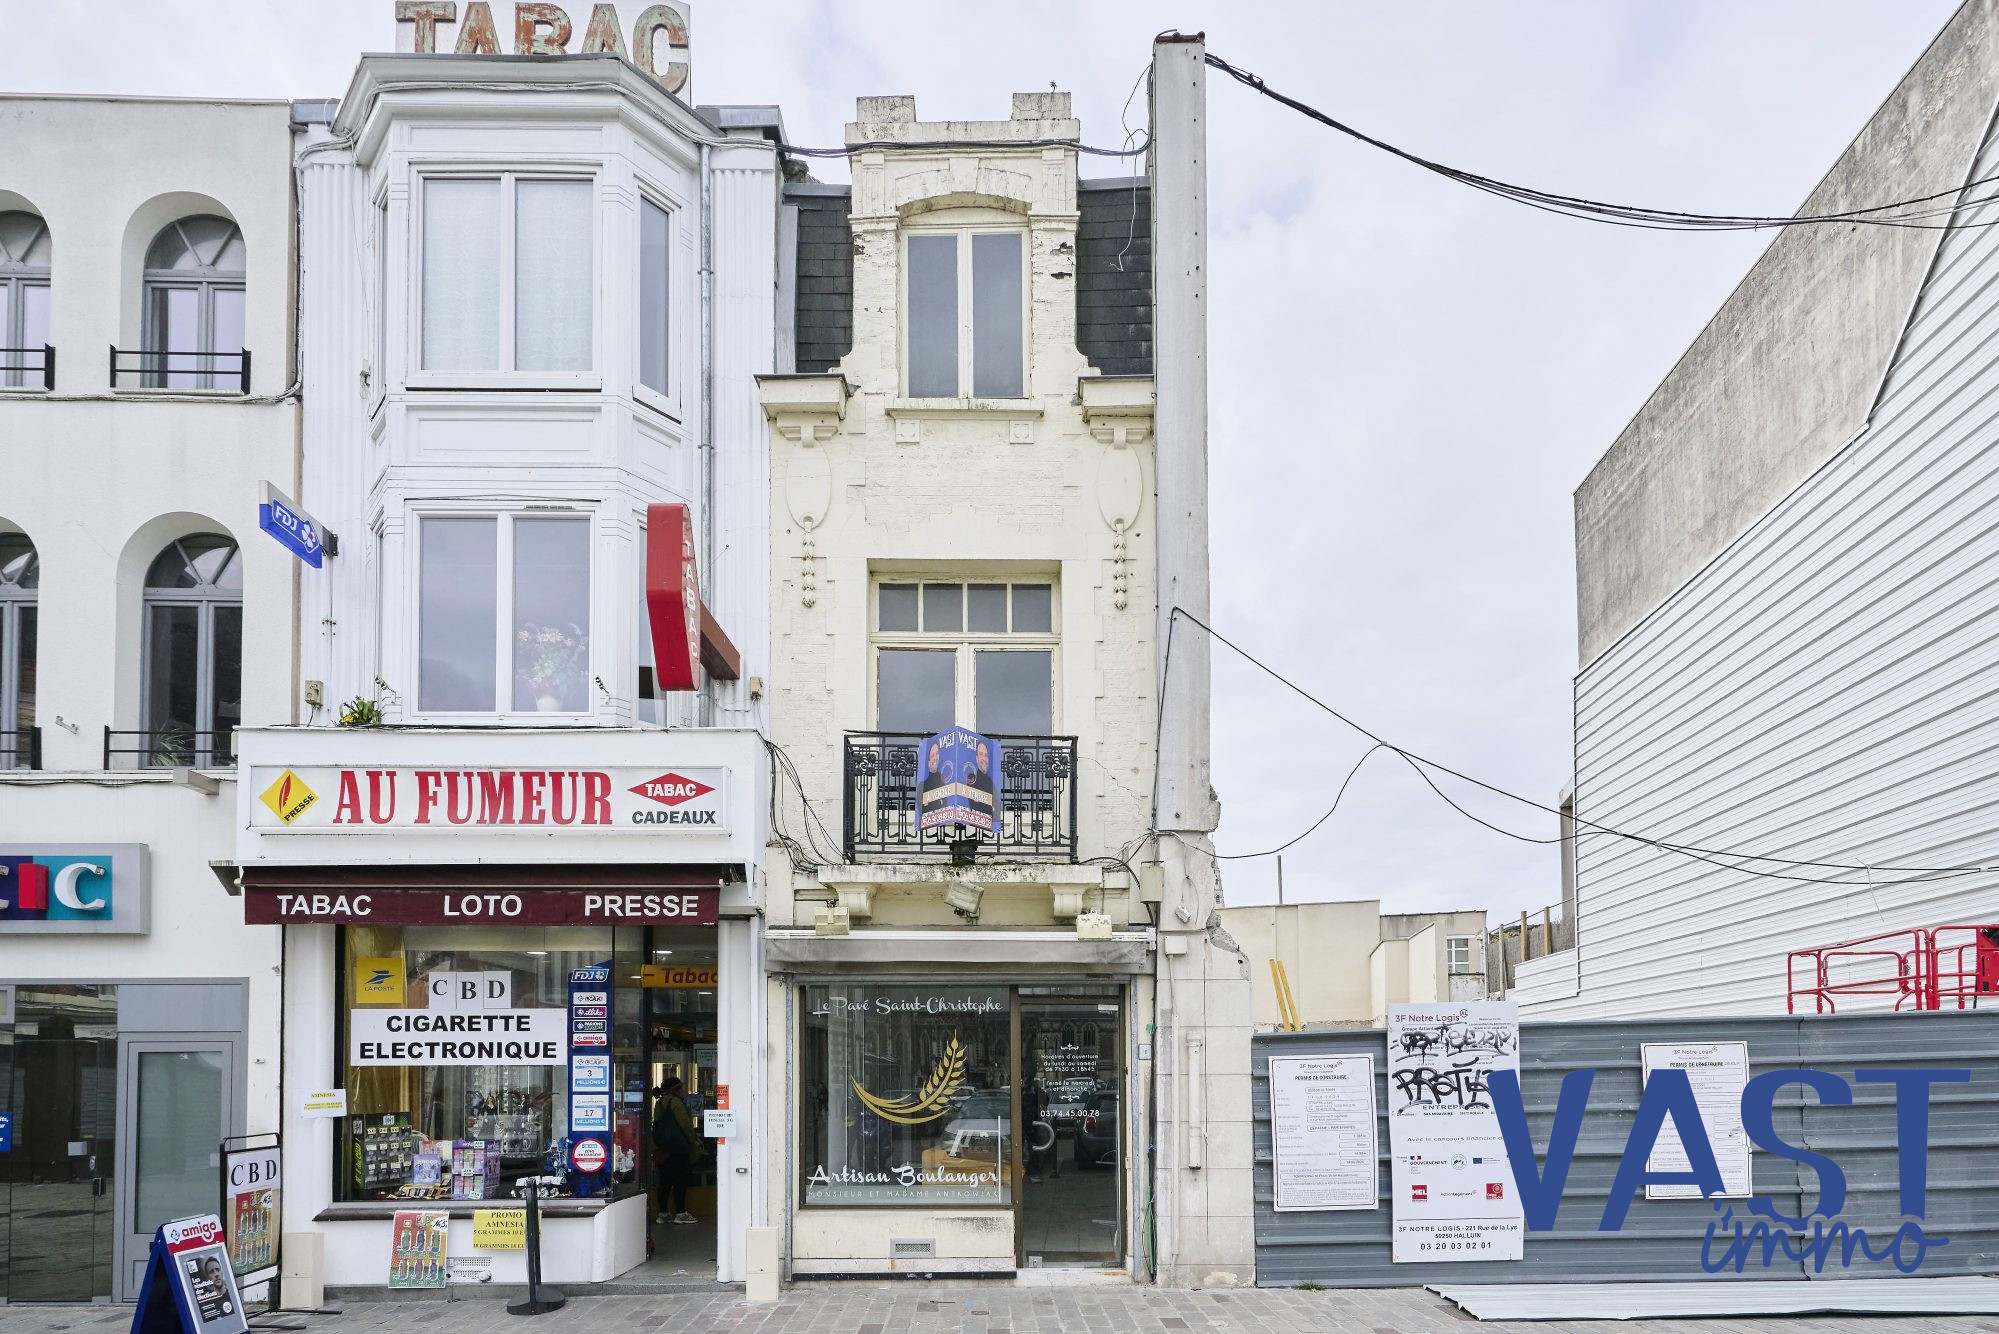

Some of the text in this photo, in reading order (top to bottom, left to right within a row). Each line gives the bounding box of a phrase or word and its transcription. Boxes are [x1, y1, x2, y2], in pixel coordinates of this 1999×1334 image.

[395, 1, 689, 94] TABAC
[276, 506, 298, 531] FDJ
[683, 540, 698, 657] TABAC
[333, 770, 613, 825] AU FUMEUR
[645, 783, 697, 797] TABAC
[284, 793, 315, 822] PRESSE
[632, 810, 716, 824] CADEAUX
[0, 863, 106, 910] IC
[277, 895, 699, 917] TABAC LOTO PRESSE
[574, 971, 594, 980] FDJ
[432, 979, 505, 1000] CBD
[813, 996, 1003, 1017] Le Pavé Saint-Christophe
[386, 1015, 531, 1032] CIGARETTE
[1408, 1014, 1434, 1022] Notre
[1436, 1014, 1460, 1022] Logis
[583, 1035, 603, 1044] amigo
[360, 1042, 557, 1059] ELECTRONIQUE
[231, 1159, 277, 1186] CBD
[807, 1164, 998, 1188] Artisan Boulanger
[181, 1221, 217, 1239] amigo
[194, 1279, 214, 1289] résultats
[197, 1291, 218, 1300] élections
